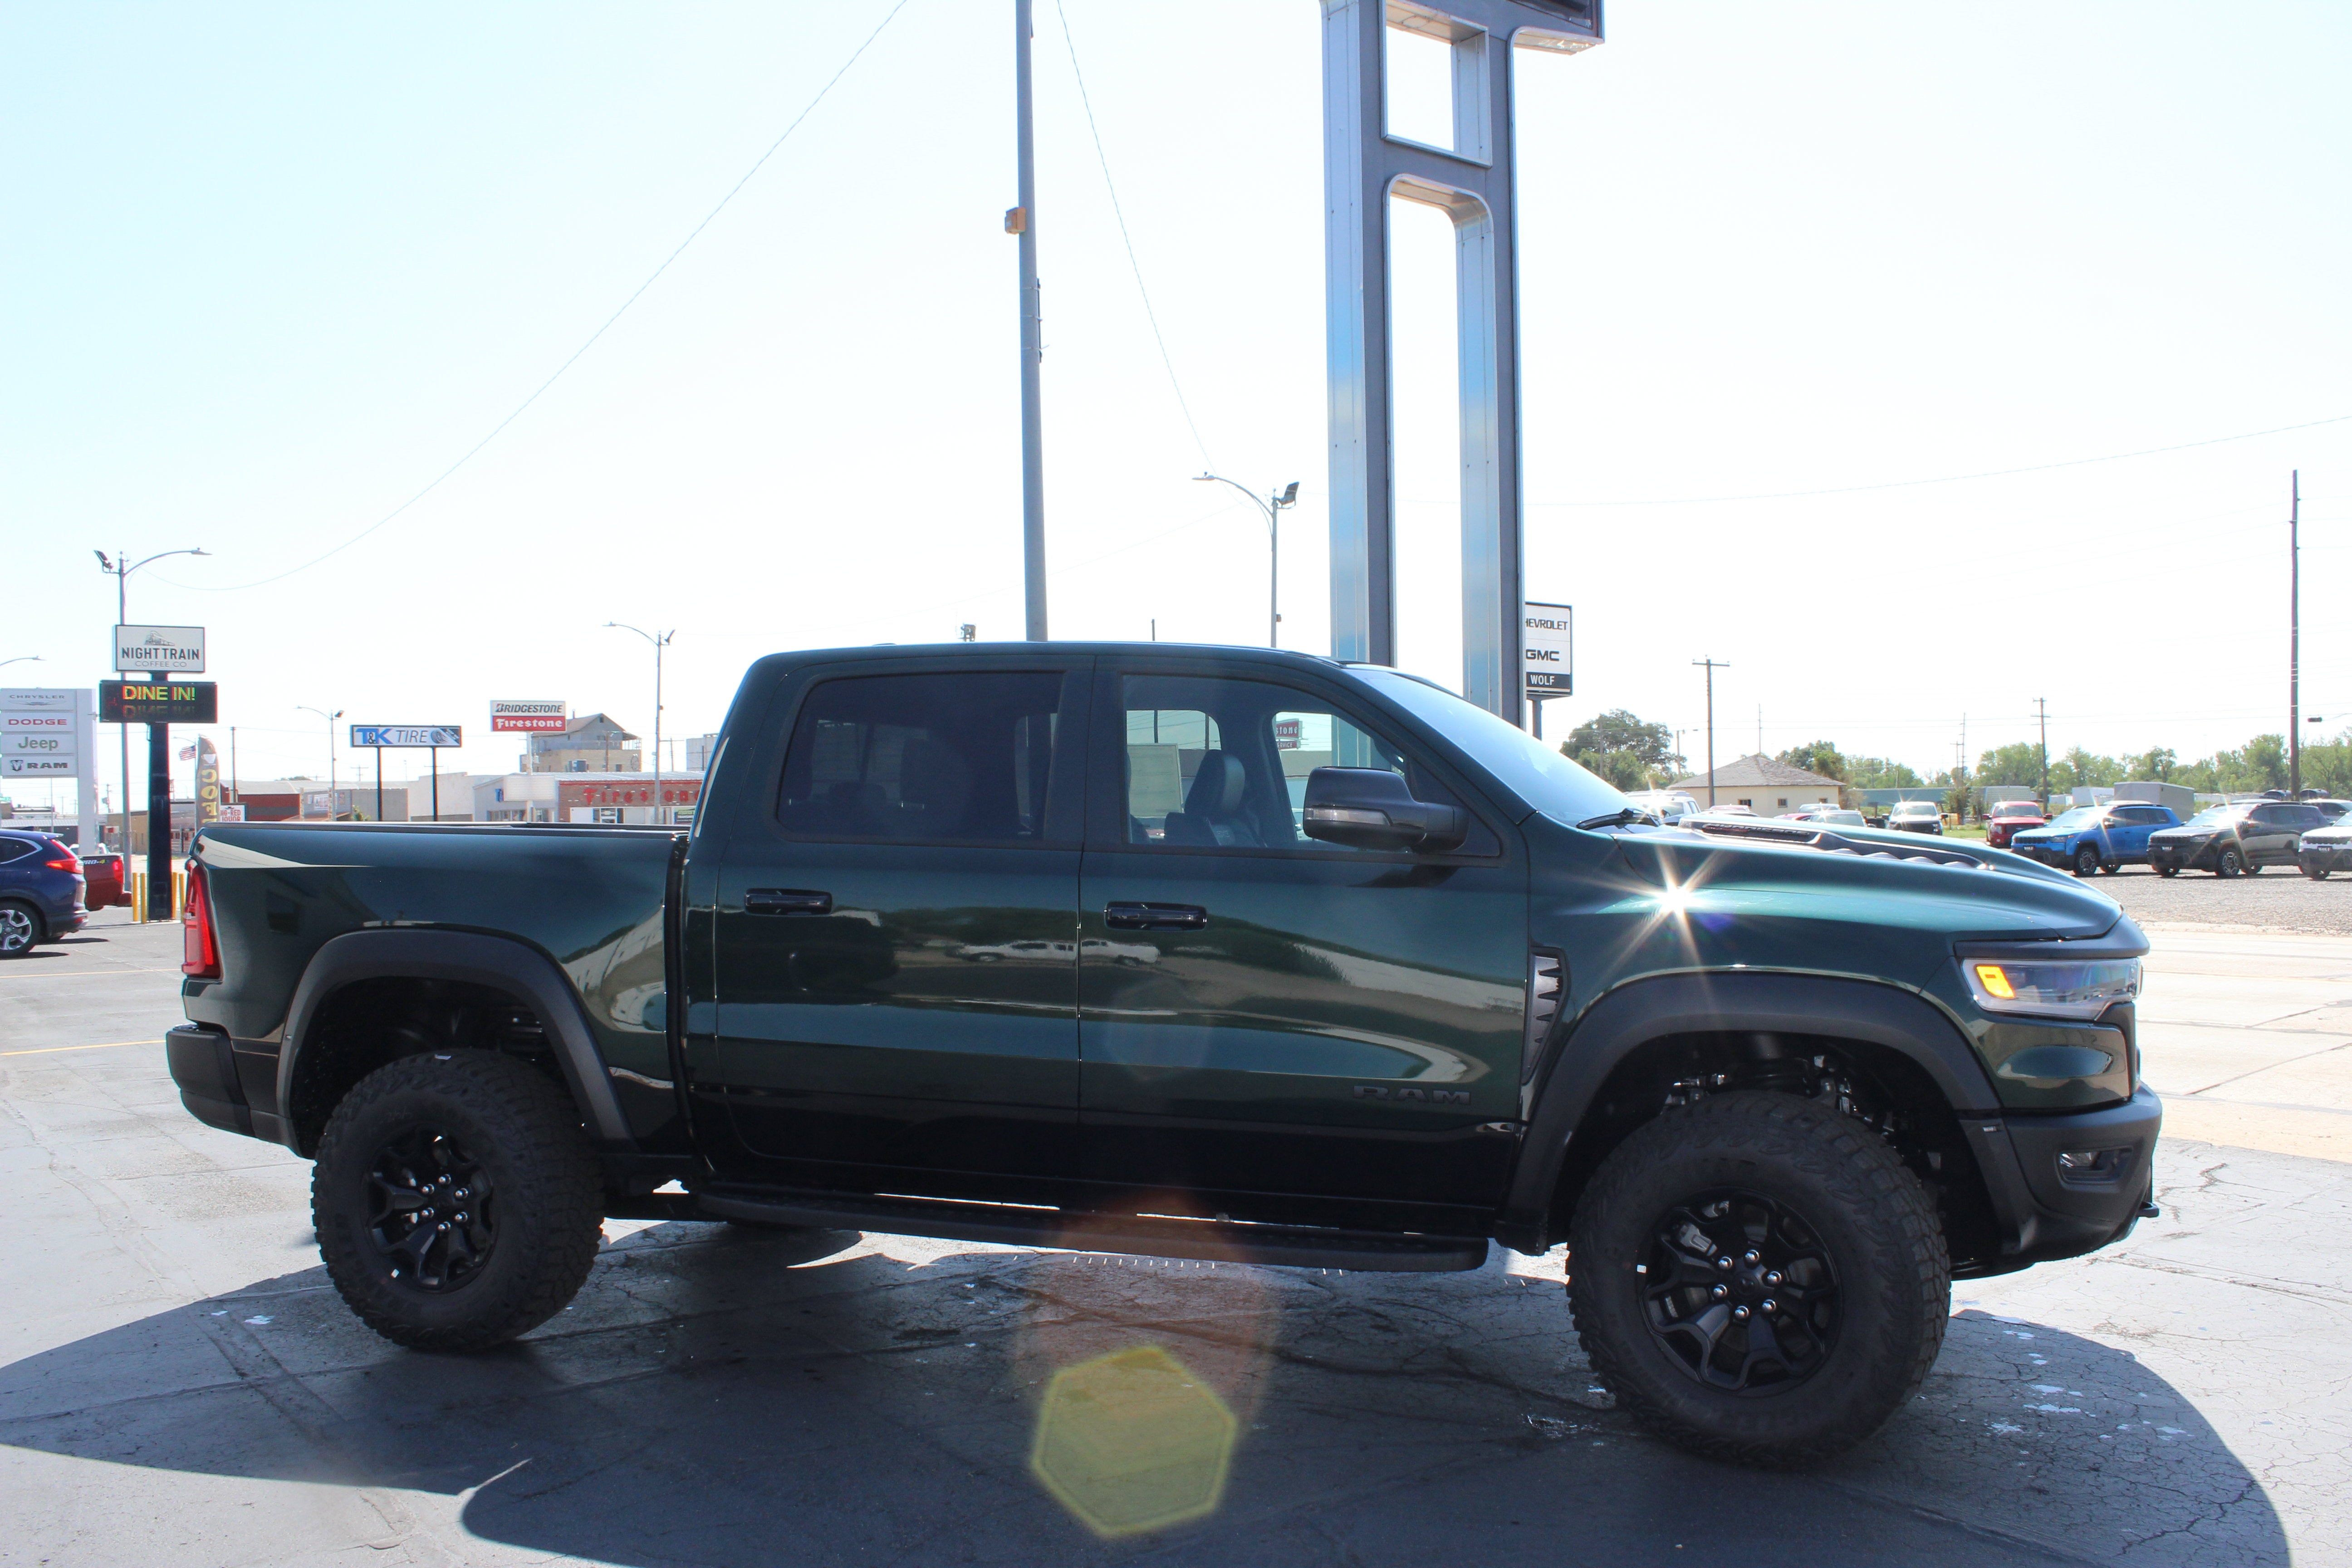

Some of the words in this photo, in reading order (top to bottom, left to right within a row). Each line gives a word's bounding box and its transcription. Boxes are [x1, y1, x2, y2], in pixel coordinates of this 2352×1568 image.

[122, 647, 160, 659] NIGHT
[162, 648, 200, 660] TRAIN
[1526, 649, 1559, 662] GMC
[1530, 675, 1555, 686] WOLF
[122, 686, 168, 700] DINE
[172, 686, 195, 701] IN!
[495, 703, 563, 713] BRIDGESTONE
[496, 718, 563, 729] Firestone
[355, 728, 394, 744] T&K
[396, 730, 428, 743] TIRE
[1276, 726, 1298, 735] stone
[18, 736, 59, 751] Jeep
[1353, 1086, 1471, 1105] RAM
